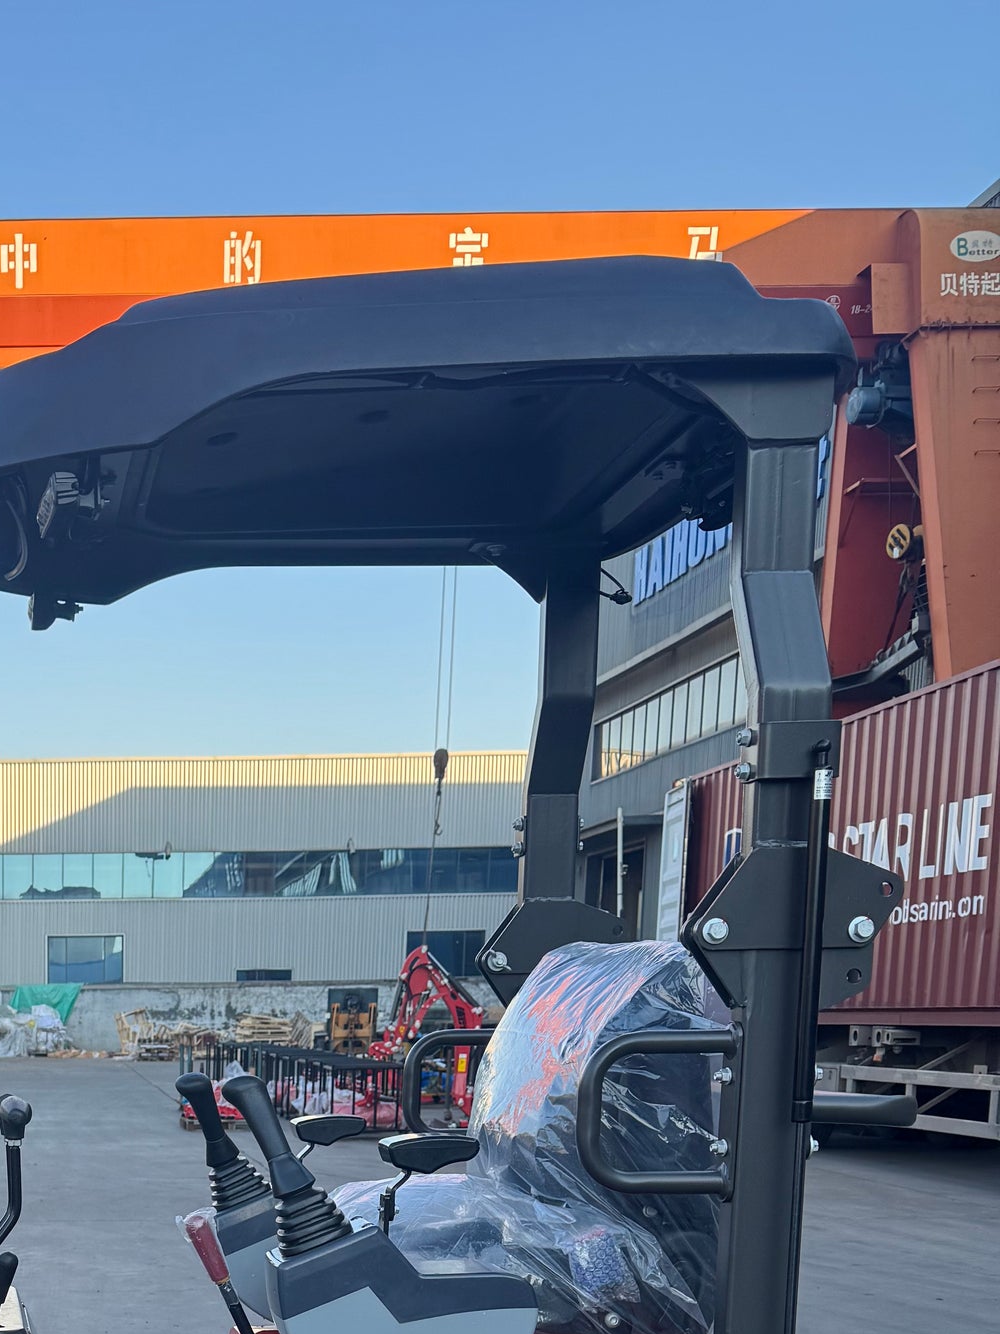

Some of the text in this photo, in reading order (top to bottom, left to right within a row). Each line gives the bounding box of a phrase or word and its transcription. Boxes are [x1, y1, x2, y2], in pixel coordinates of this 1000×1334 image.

[0, 233, 37, 289] 中
[223, 231, 262, 285] 的
[918, 792, 993, 880] LINE
